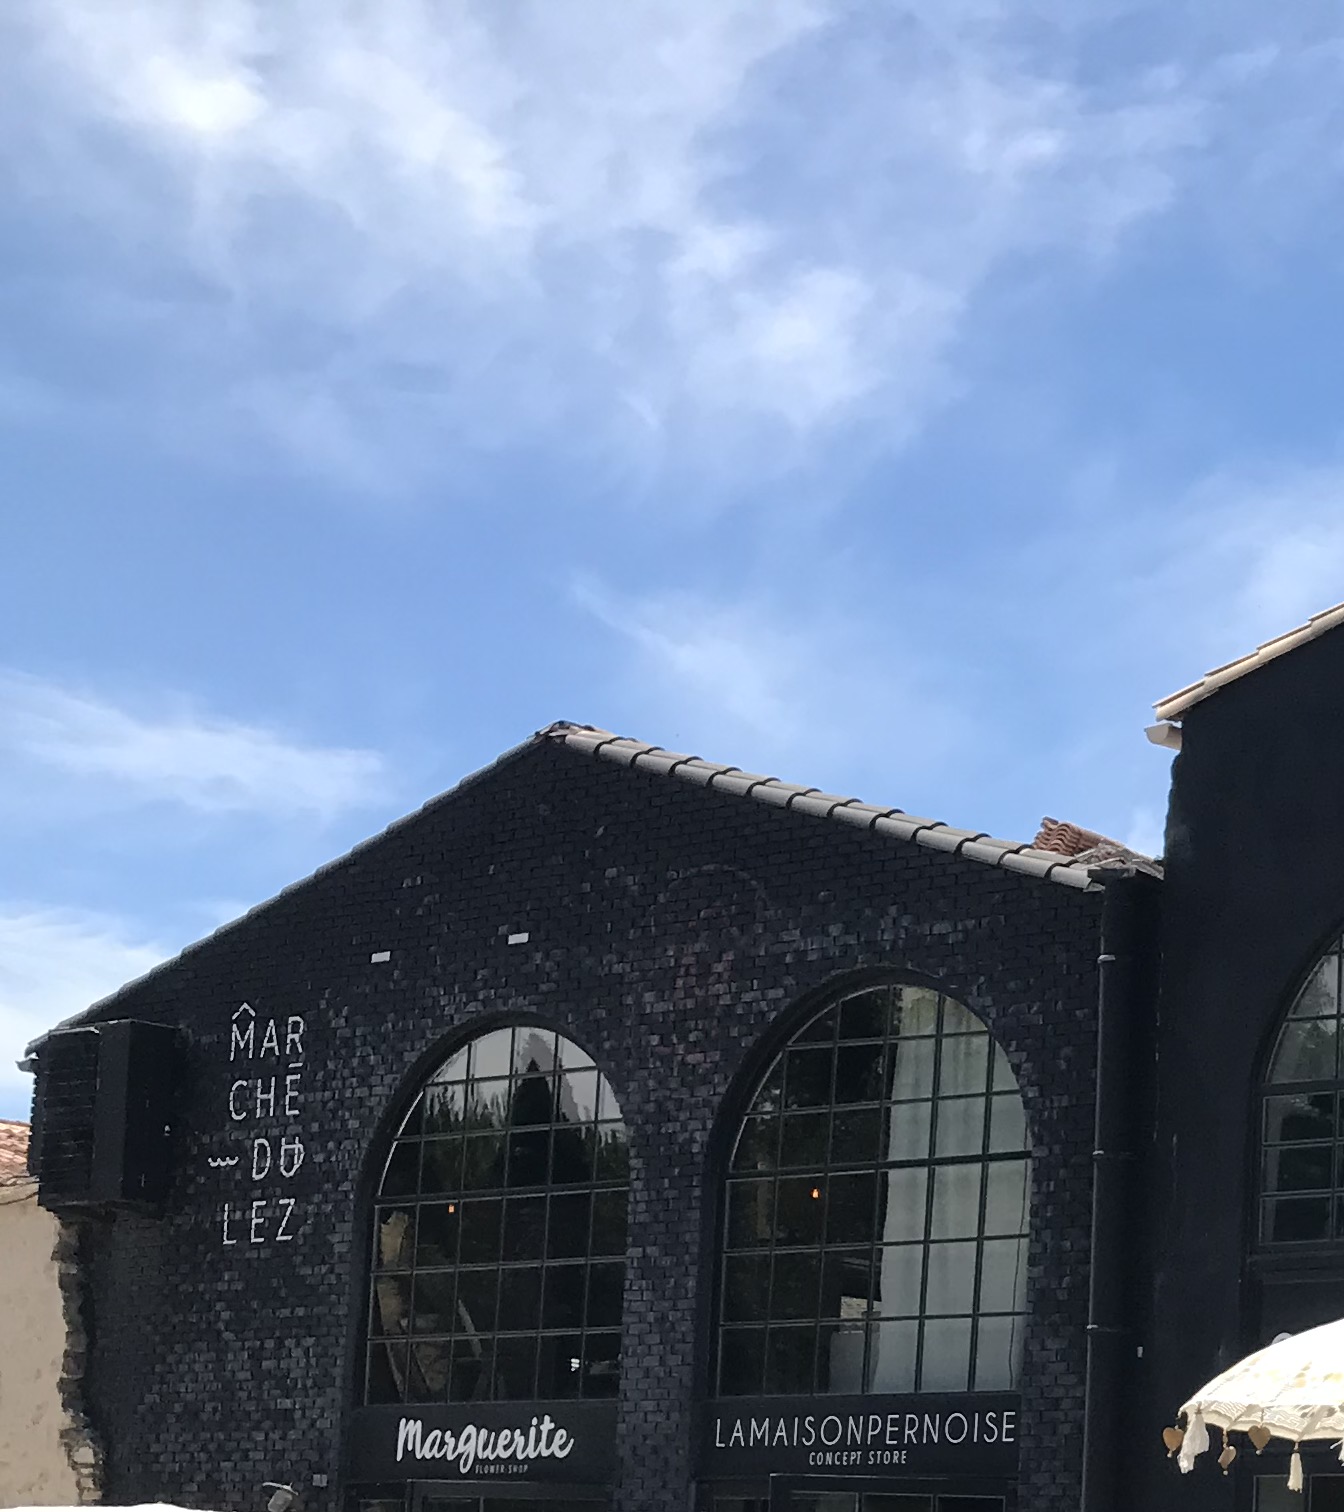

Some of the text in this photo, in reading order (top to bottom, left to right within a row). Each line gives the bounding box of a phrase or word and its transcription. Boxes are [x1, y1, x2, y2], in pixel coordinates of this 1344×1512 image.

[252, 1136, 306, 1181] DU
[222, 1197, 297, 1245] LEZ
[396, 1413, 575, 1474] Marguerite
[714, 1410, 1017, 1449] LAMAISONPERNOISE
[808, 1449, 908, 1466] CONCEPT STORE
